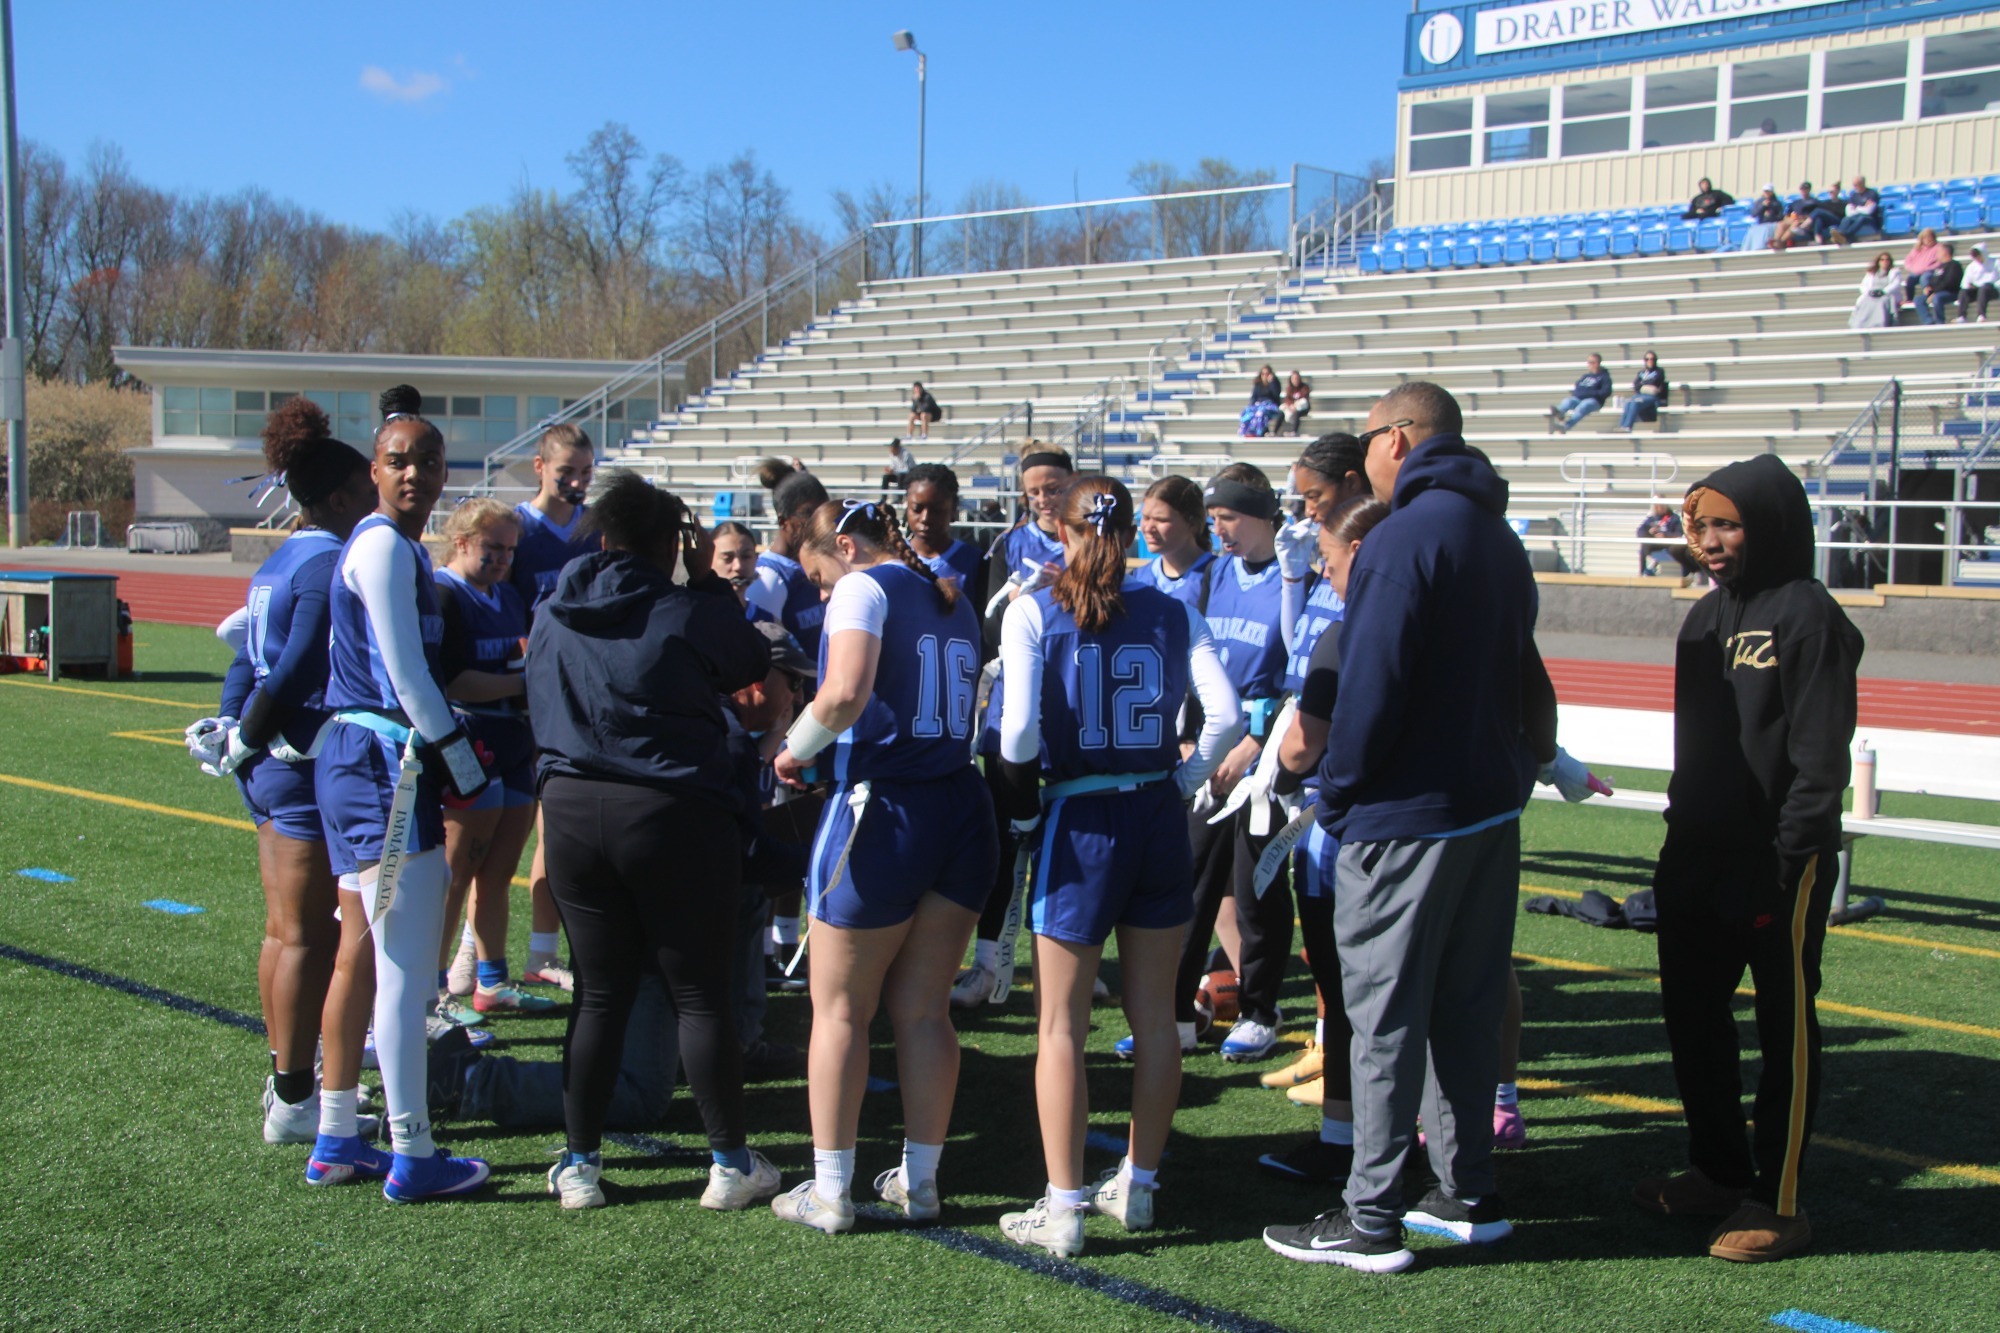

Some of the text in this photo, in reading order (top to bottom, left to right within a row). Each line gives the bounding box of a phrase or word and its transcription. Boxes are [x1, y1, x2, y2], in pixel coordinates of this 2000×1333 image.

[1494, 1, 1634, 45] DRAPER
[912, 633, 977, 740] 16
[1073, 644, 1164, 750] 12
[378, 810, 407, 911] IMMACULATA
